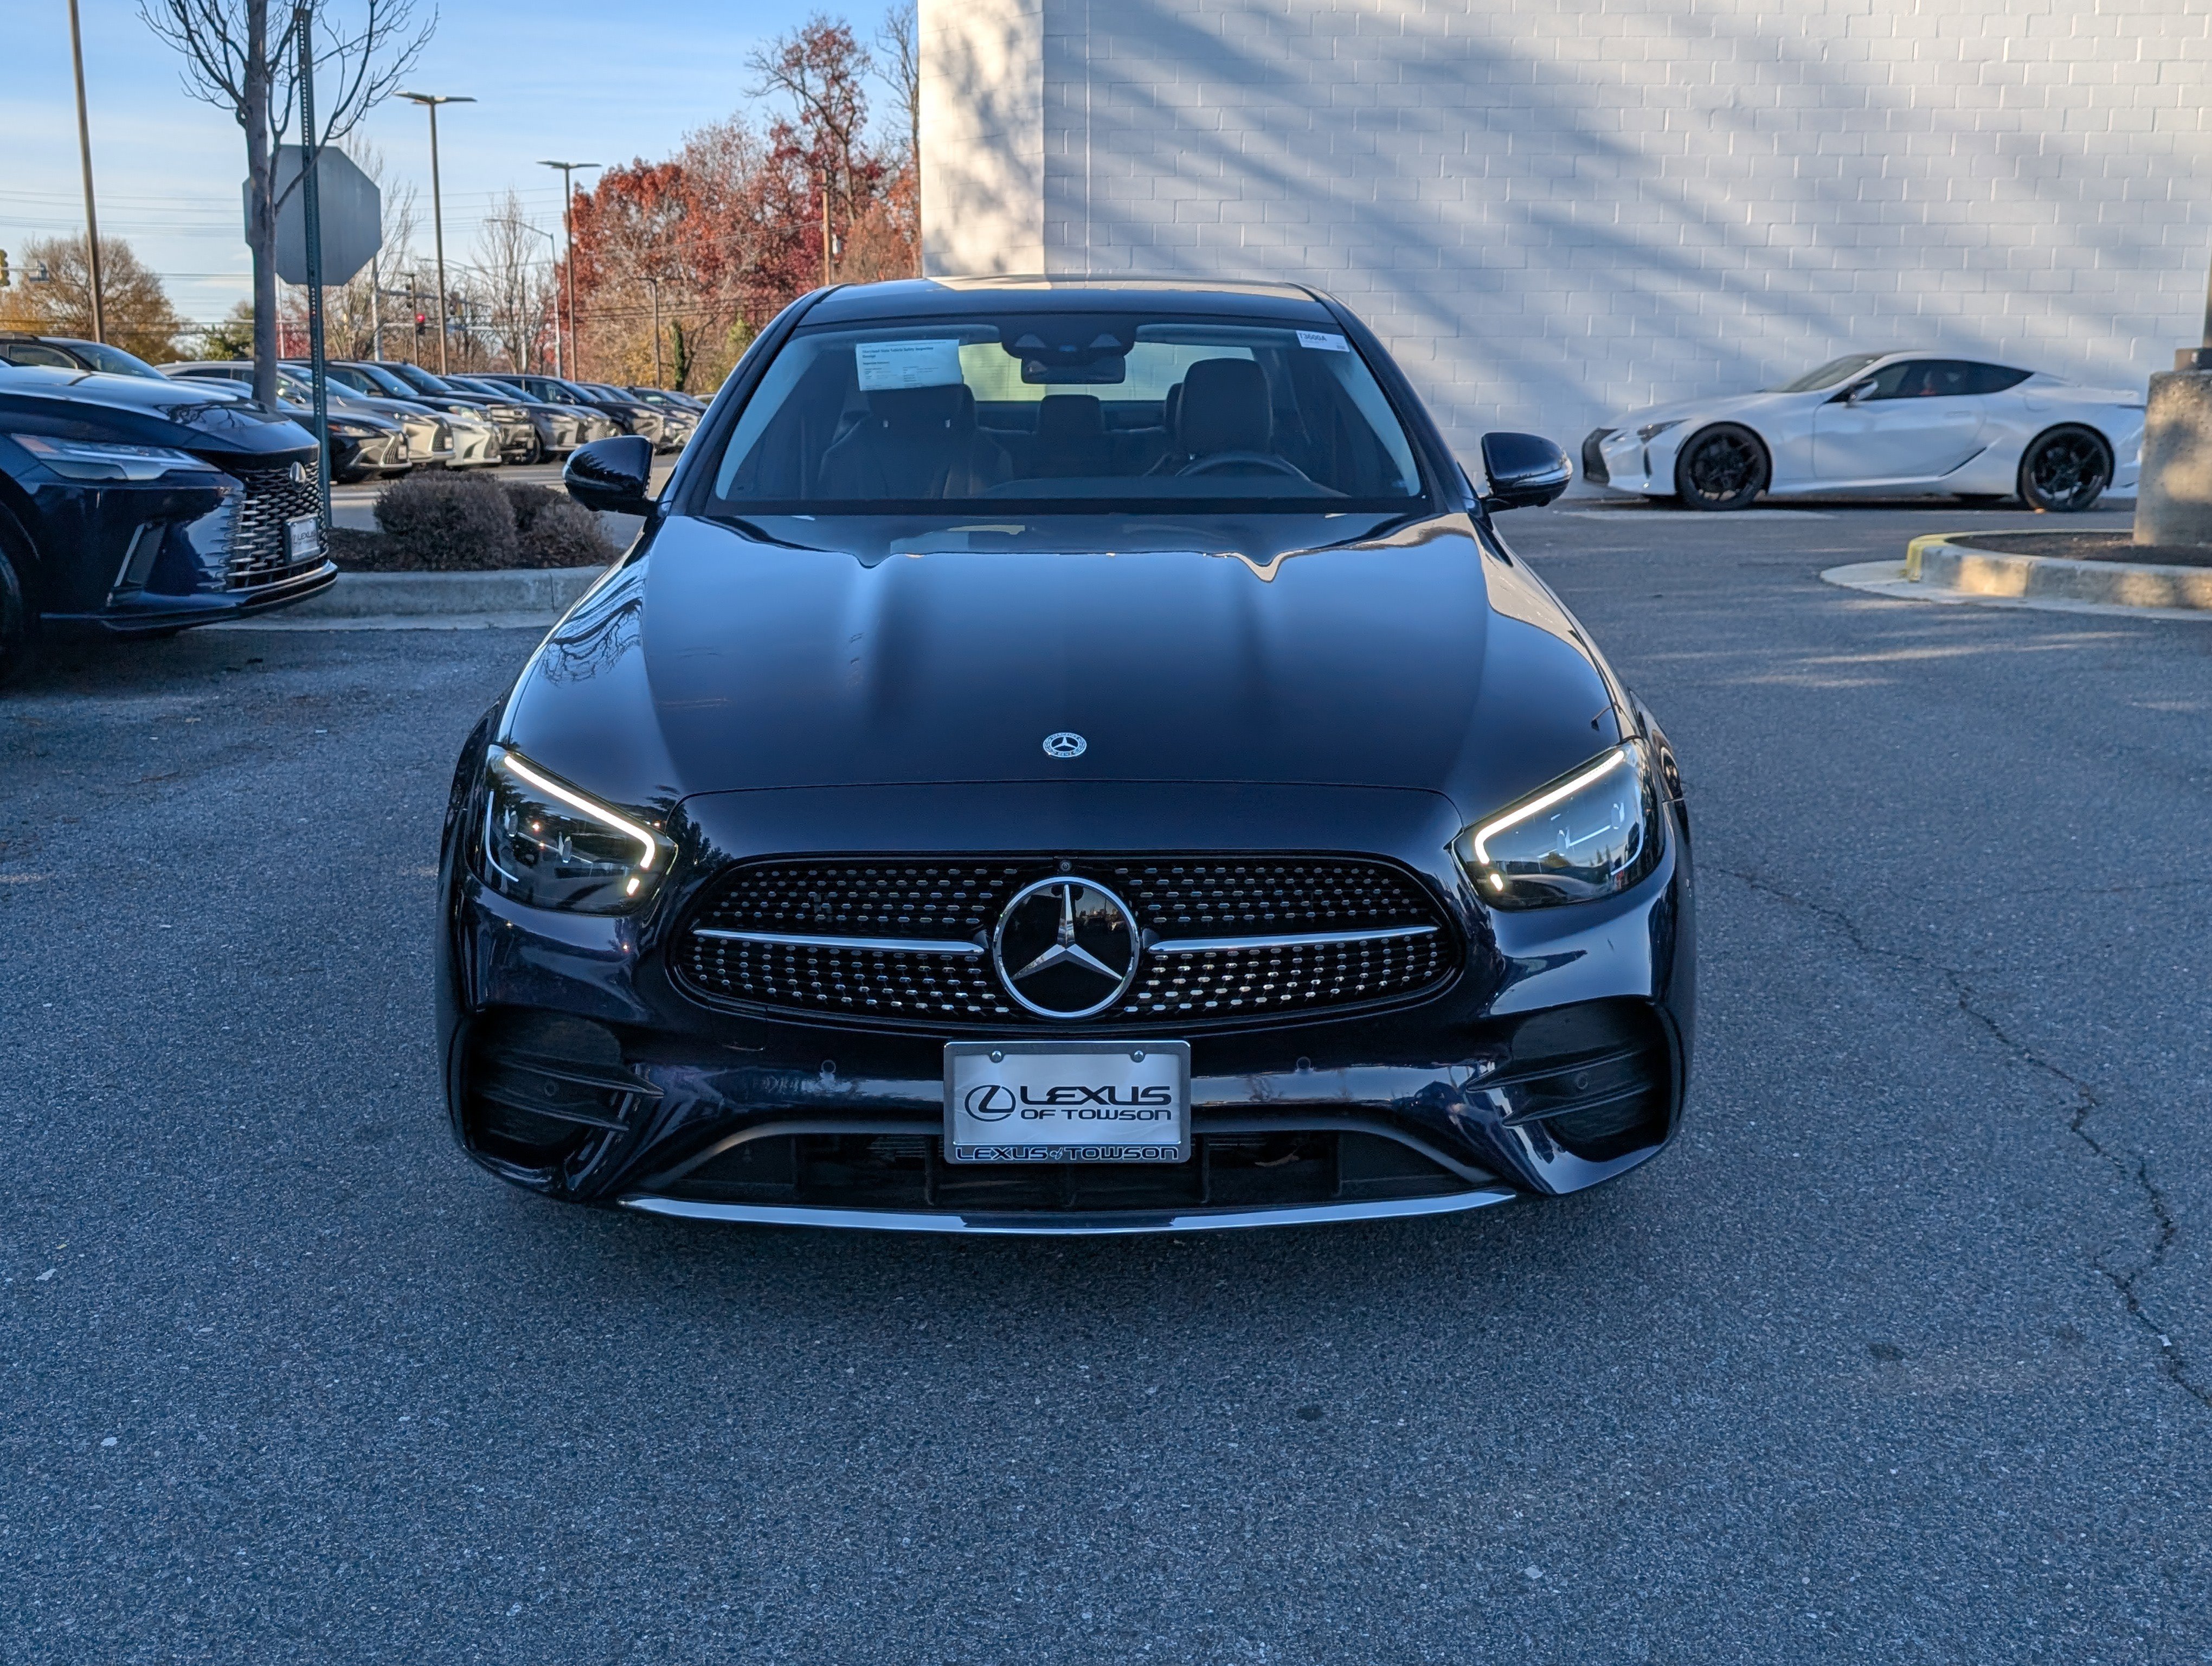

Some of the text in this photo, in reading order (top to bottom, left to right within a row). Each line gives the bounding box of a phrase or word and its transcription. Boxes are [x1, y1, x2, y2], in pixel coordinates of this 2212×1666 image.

[1020, 1085, 1172, 1106] LEXUS
[1021, 1109, 1172, 1121] OF TOWSON
[955, 1146, 1179, 1161] LEXUS of TOWSON
